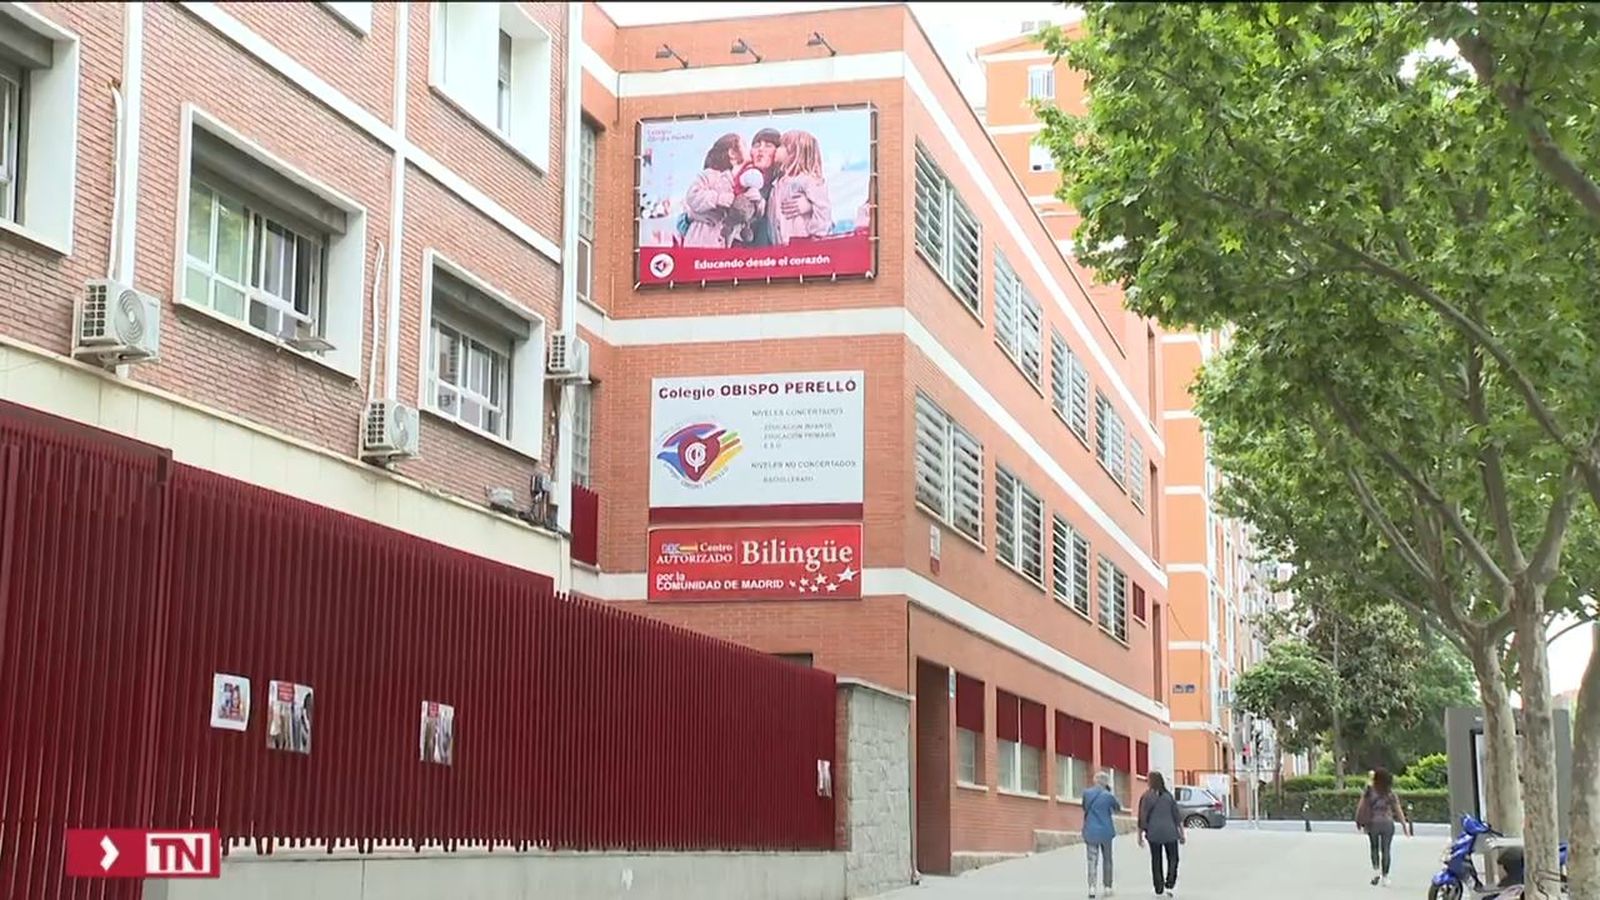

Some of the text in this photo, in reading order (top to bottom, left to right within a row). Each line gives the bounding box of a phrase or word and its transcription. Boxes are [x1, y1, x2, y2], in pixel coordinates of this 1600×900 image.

[694, 254, 830, 270] Educando desde el corazón
[658, 378, 857, 401] Colegio OBISPO PERELLÓ
[751, 407, 844, 417] NIVELES CONCERTADOS
[751, 461, 783, 469] NIVELES
[798, 460, 857, 468] CONCERTADOS
[700, 542, 733, 552] Centro
[656, 537, 853, 572] AUTORIZADO Bilingüe
[656, 571, 686, 584] por la
[656, 579, 784, 591] COMUNIDAD DE MADRID
